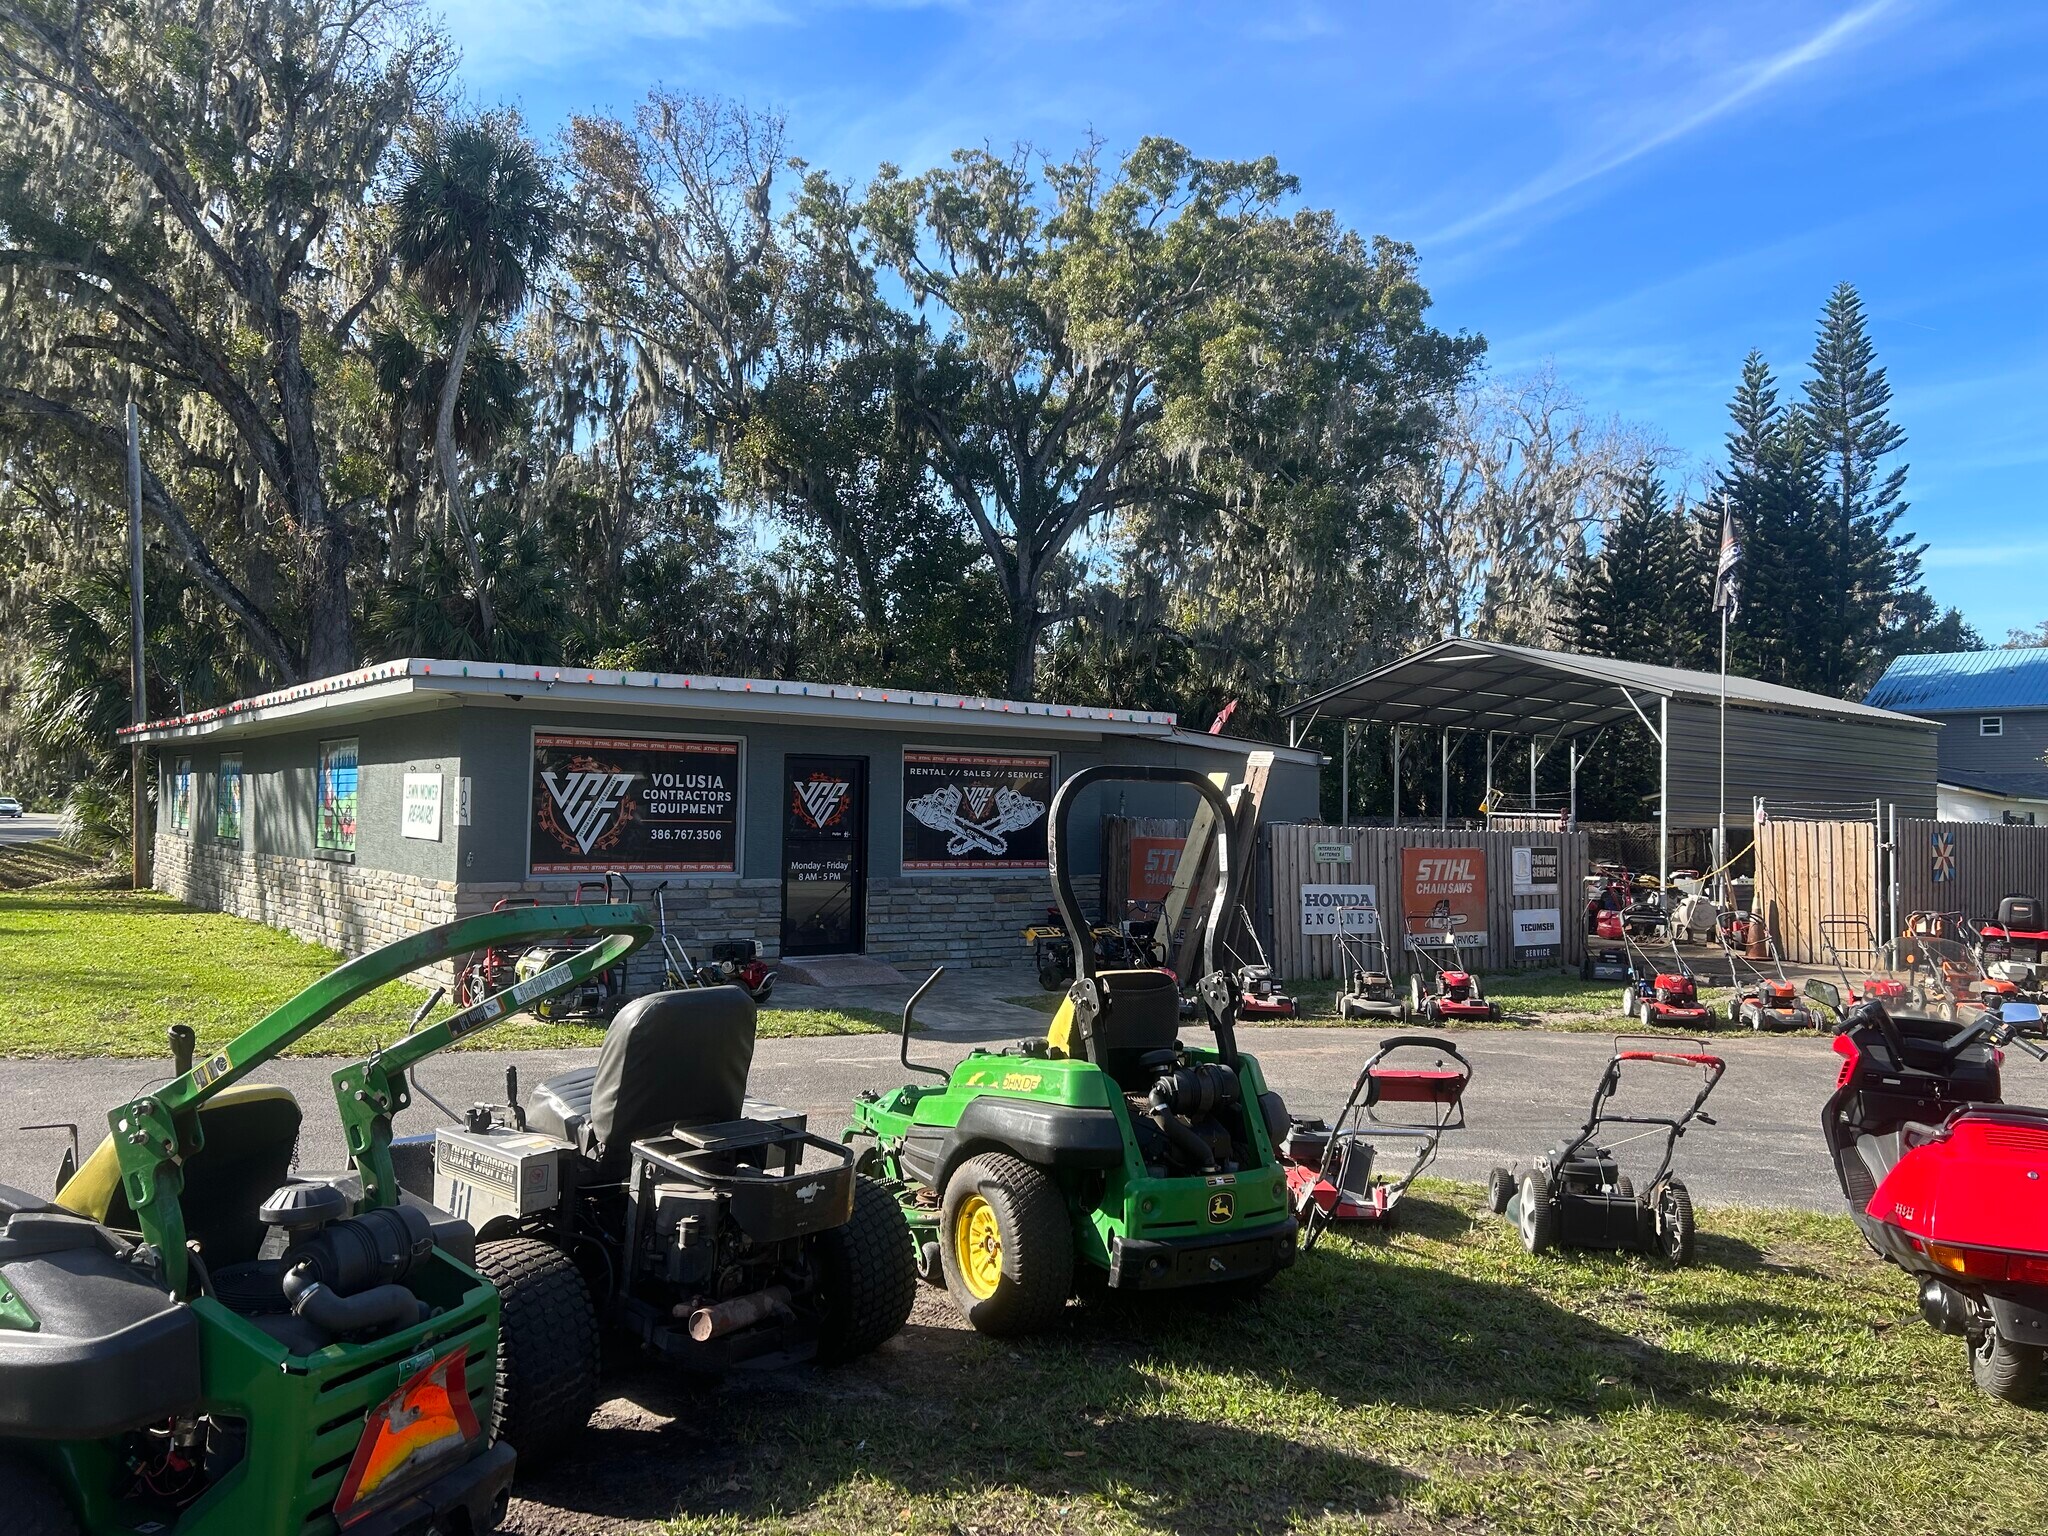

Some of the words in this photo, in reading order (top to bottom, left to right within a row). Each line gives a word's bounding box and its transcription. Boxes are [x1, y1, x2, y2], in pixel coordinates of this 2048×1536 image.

[652, 773, 724, 788] VOLUSIA
[643, 790, 731, 801] CONTRACTORS
[650, 803, 724, 814] EQUIPMENT
[651, 829, 722, 840] 386.767.3506
[1145, 849, 1181, 871] STI
[1532, 855, 1557, 865] FACTORY
[791, 861, 821, 872] Monday
[827, 861, 848, 872] Friday
[1416, 859, 1476, 880] STIHL
[1533, 867, 1556, 877] SERVICE
[1305, 893, 1372, 907] HONDA
[1305, 913, 1373, 925] ENGNES
[1520, 923, 1554, 932] TECUMSEH
[1455, 935, 1478, 945] RVICE
[1525, 949, 1550, 957] SERVICE
[450, 1144, 473, 1168] DIXIE
[473, 1153, 515, 1184] CHOPPER
